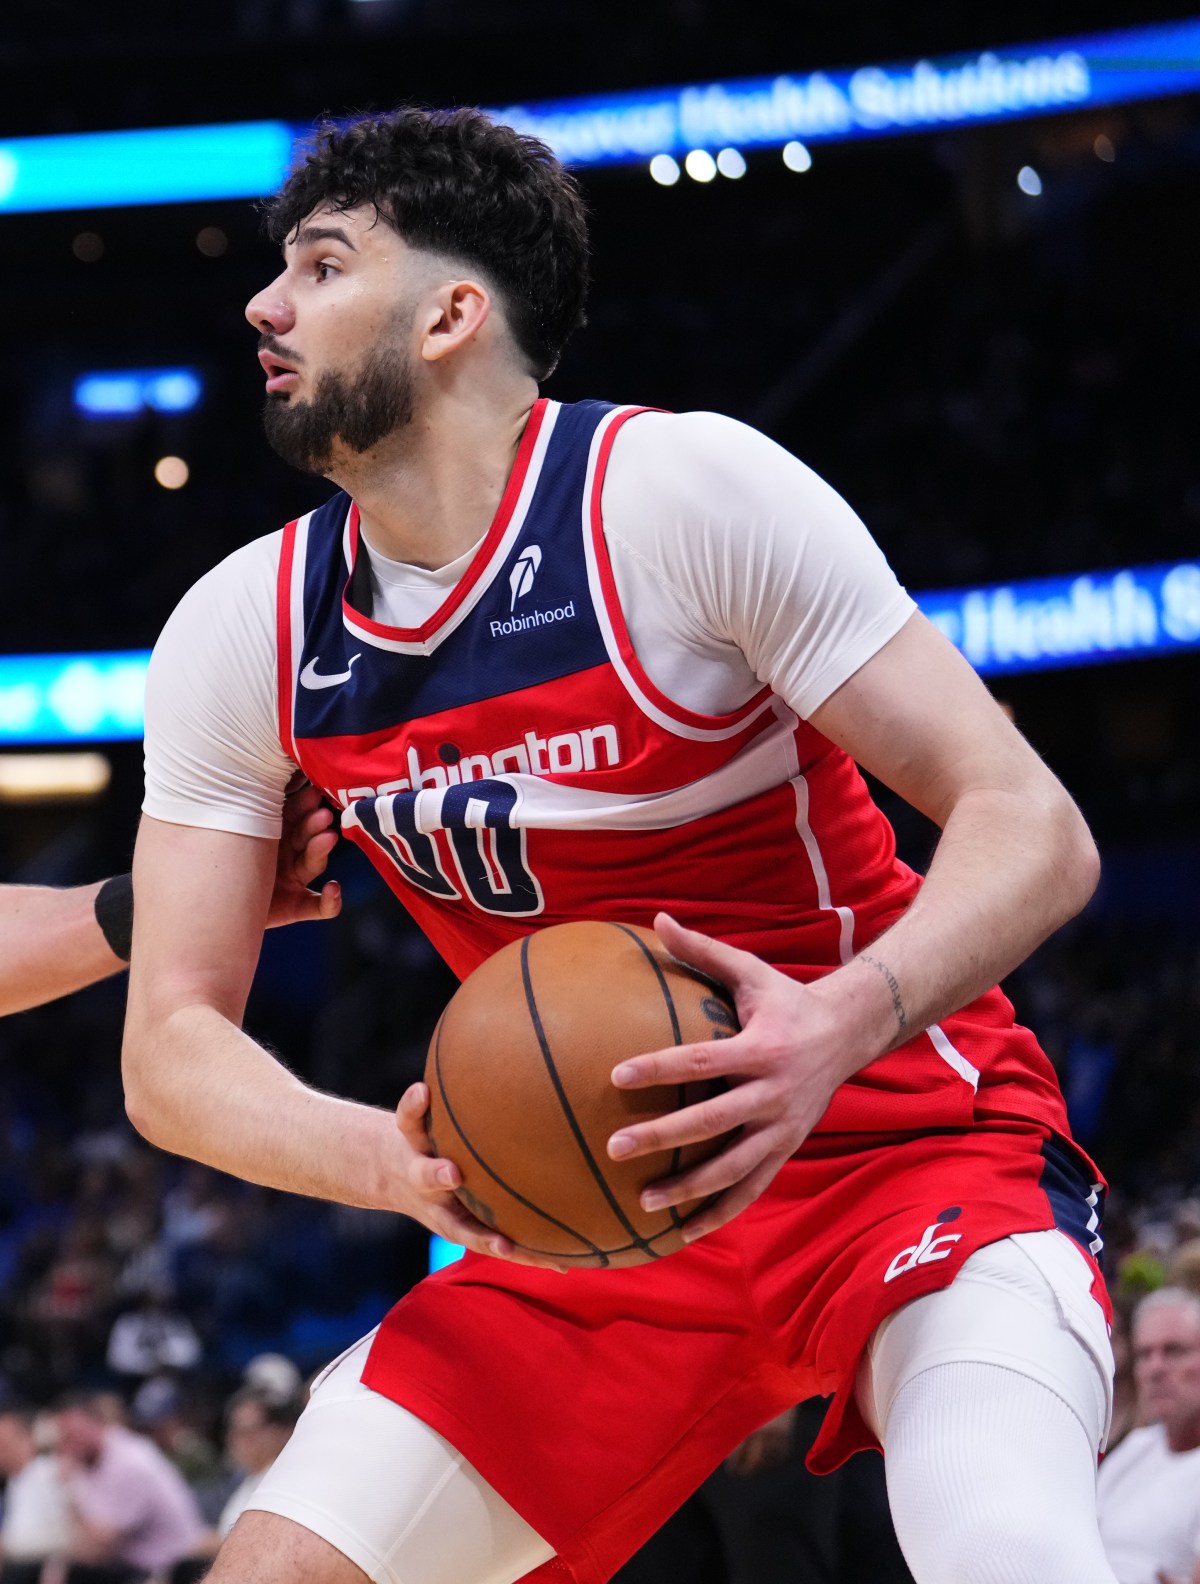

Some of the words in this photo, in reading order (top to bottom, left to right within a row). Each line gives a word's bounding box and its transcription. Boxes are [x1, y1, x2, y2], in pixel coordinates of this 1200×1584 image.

[679, 71, 850, 138] Health
[849, 53, 1090, 129] Solutions
[490, 600, 576, 637] Robinhood
[962, 569, 1157, 666] Health
